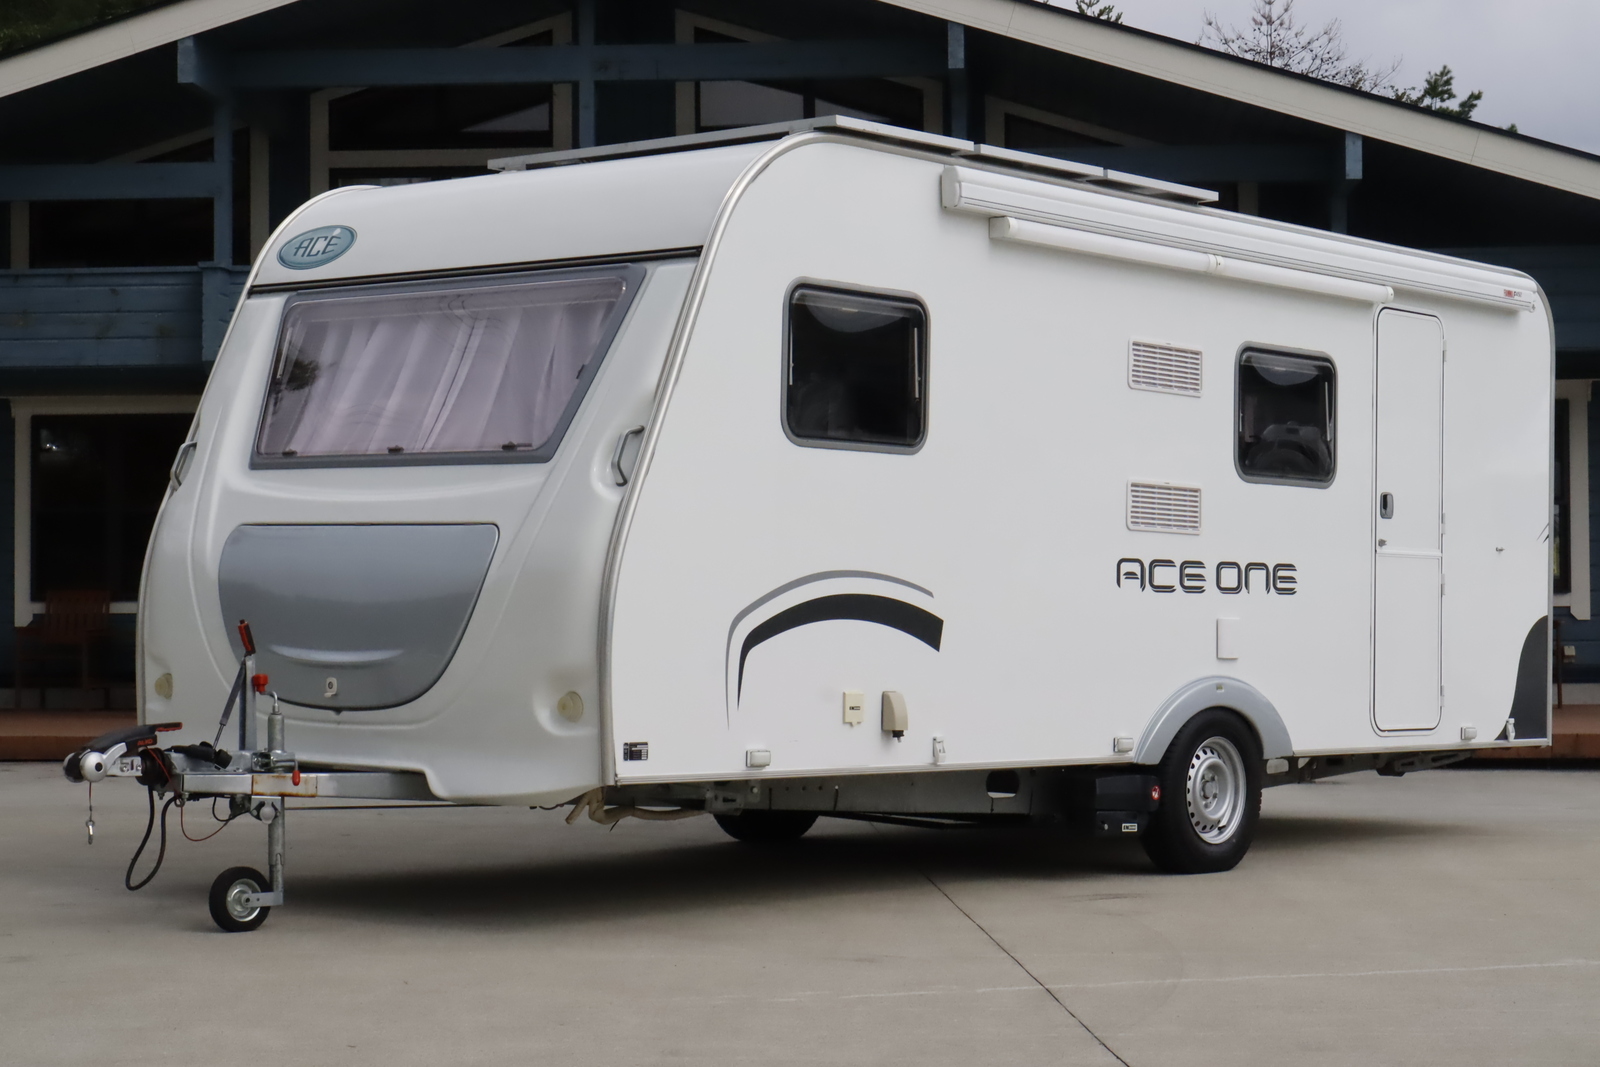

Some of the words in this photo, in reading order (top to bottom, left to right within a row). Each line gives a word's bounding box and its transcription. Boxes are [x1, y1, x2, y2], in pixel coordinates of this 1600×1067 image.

[293, 235, 341, 257] ACE
[1116, 557, 1206, 593] ACE
[1215, 561, 1298, 595] ONE
